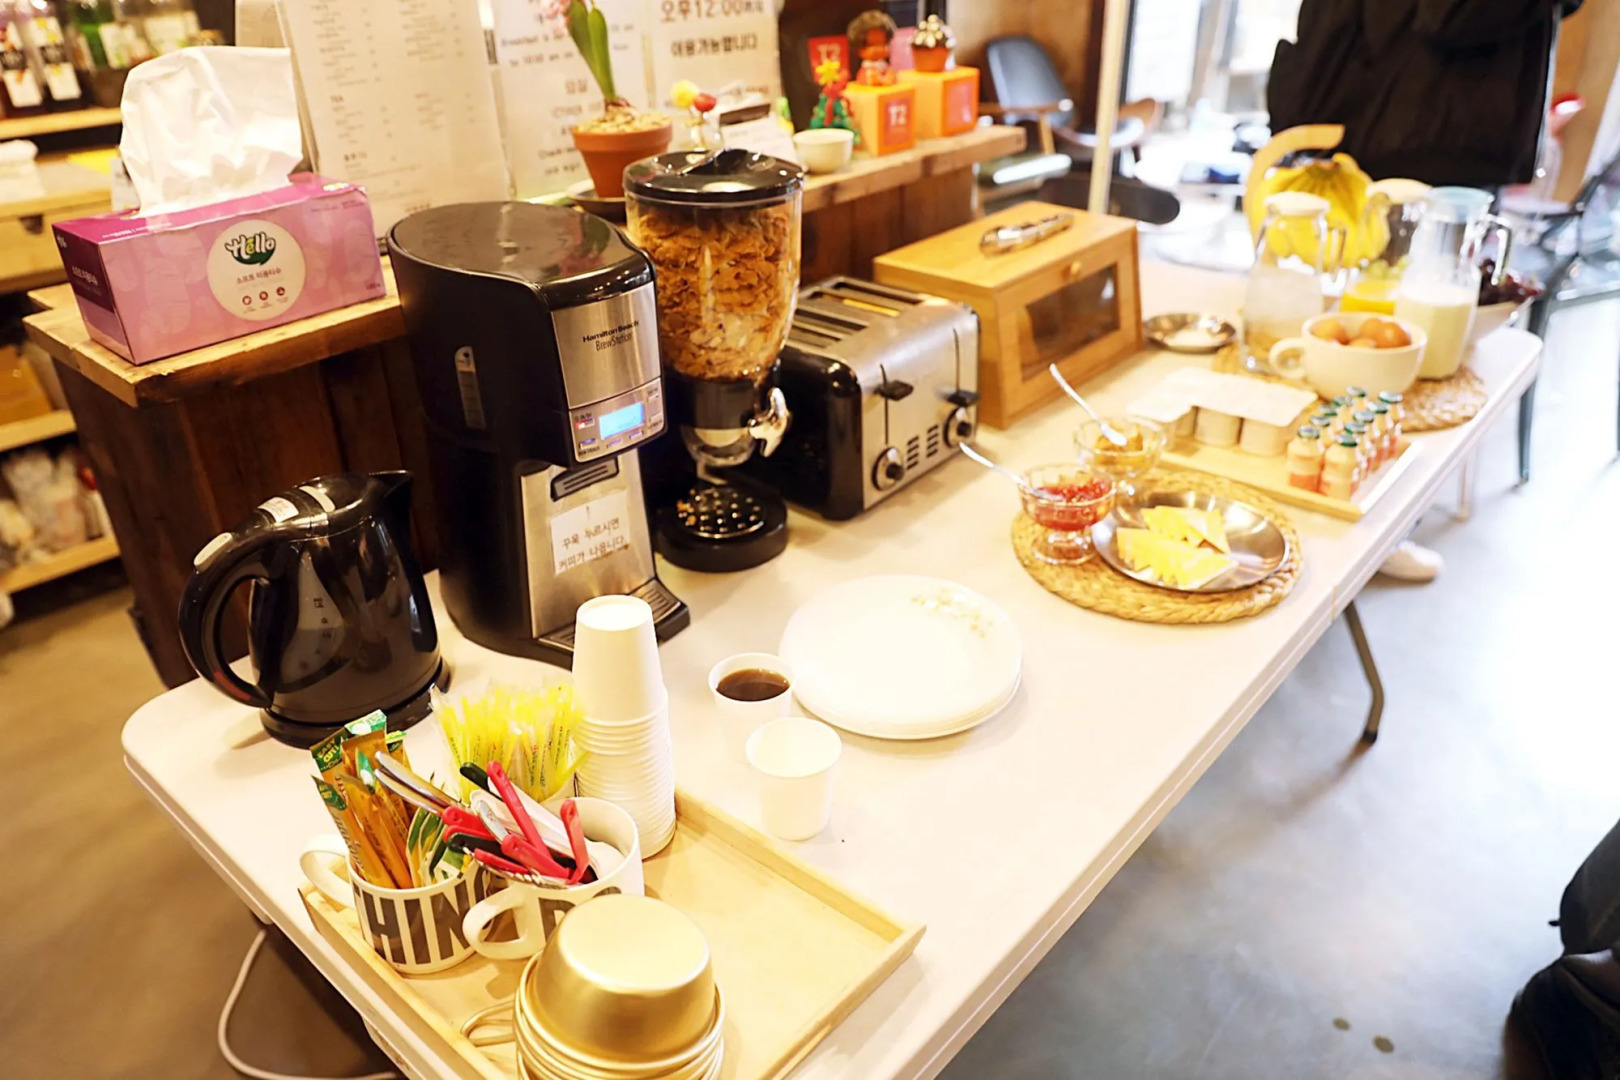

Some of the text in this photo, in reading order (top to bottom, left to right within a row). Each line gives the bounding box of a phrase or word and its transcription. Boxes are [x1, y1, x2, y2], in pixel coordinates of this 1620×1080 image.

[225, 231, 276, 260] Hello
[582, 320, 639, 343] Hamilton Beach
[353, 869, 492, 965] HIN
